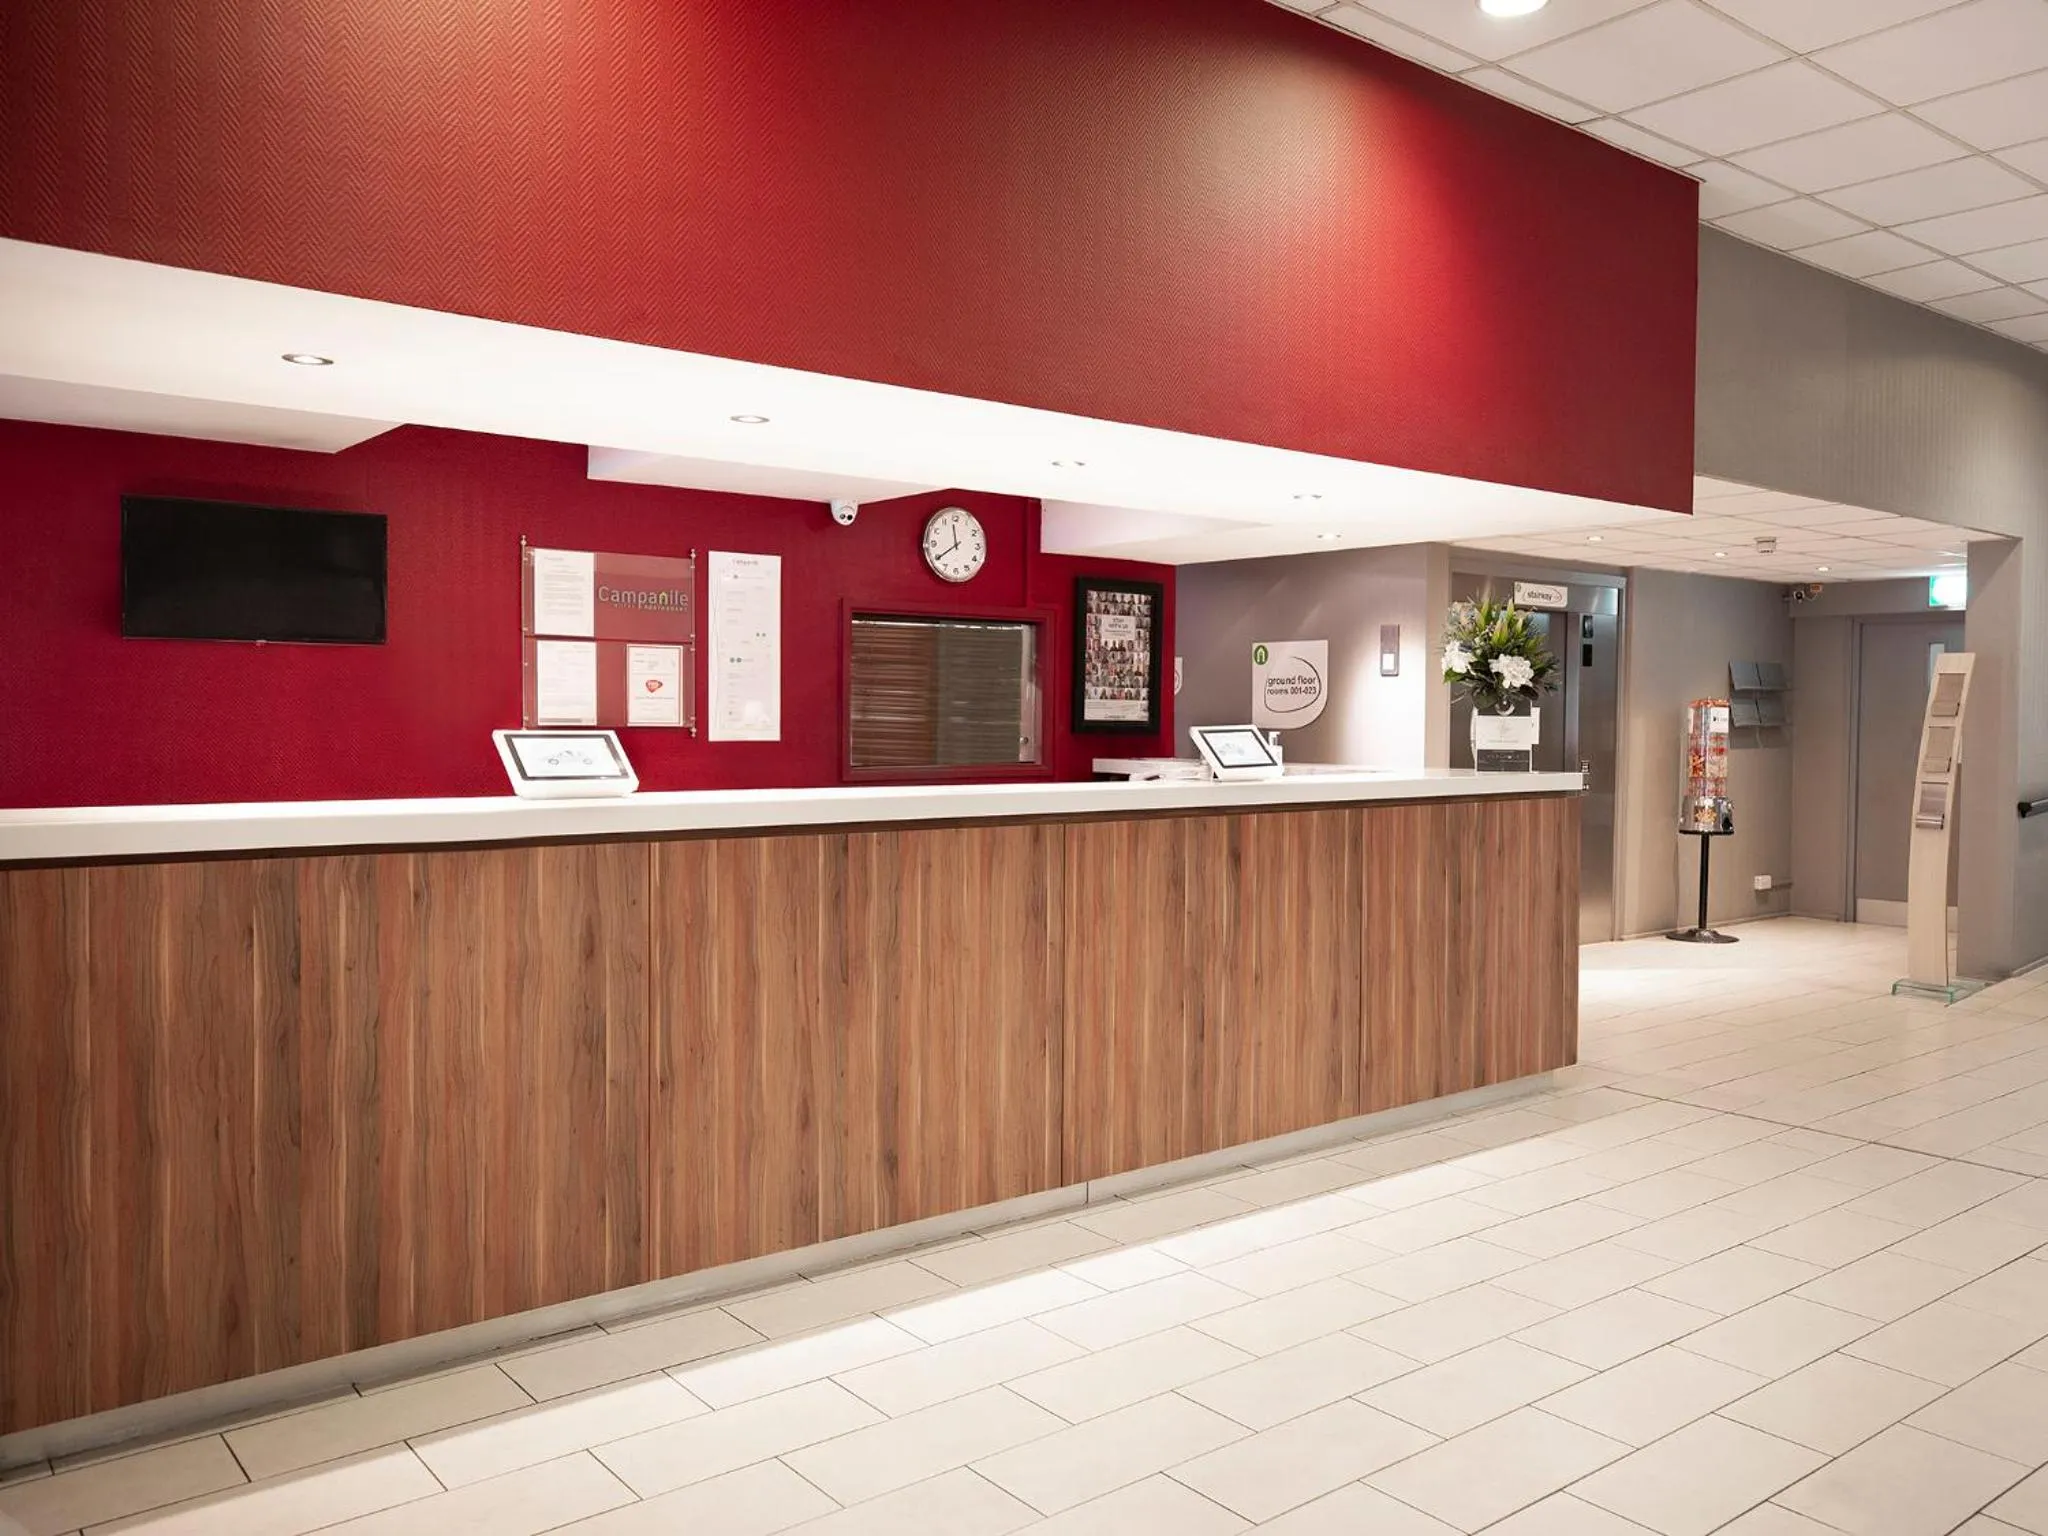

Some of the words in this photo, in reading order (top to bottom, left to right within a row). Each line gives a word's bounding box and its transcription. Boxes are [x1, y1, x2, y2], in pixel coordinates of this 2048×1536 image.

[598, 585, 689, 607] Campanile
[1268, 676, 1296, 687] ground
[1297, 674, 1316, 685] floor
